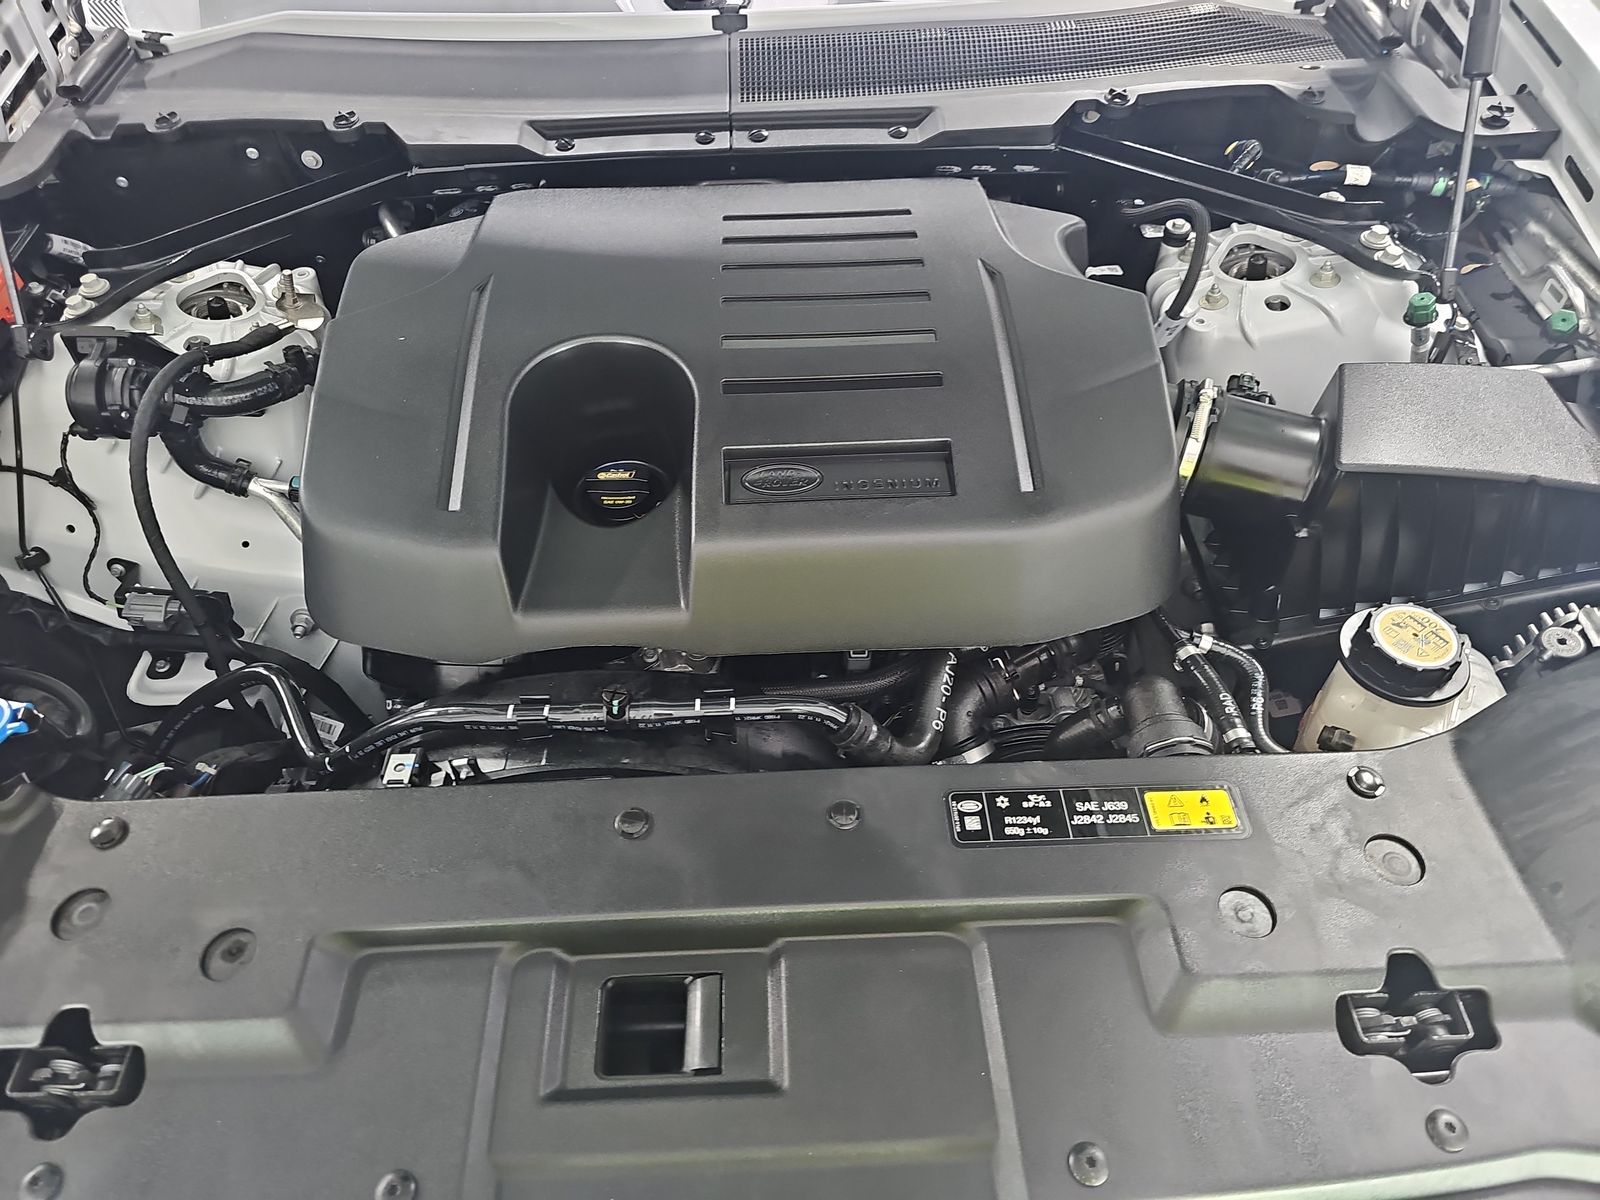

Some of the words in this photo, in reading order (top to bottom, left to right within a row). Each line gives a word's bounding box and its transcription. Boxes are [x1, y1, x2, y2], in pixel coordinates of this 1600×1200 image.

[758, 469, 797, 478] LAND
[834, 478, 941, 492] INGENIUM
[1075, 801, 1100, 812] SAE
[1101, 801, 1129, 811] J639
[1004, 815, 1041, 826] R1234yf
[1071, 814, 1105, 825] J2842
[1106, 813, 1140, 824] J2845
